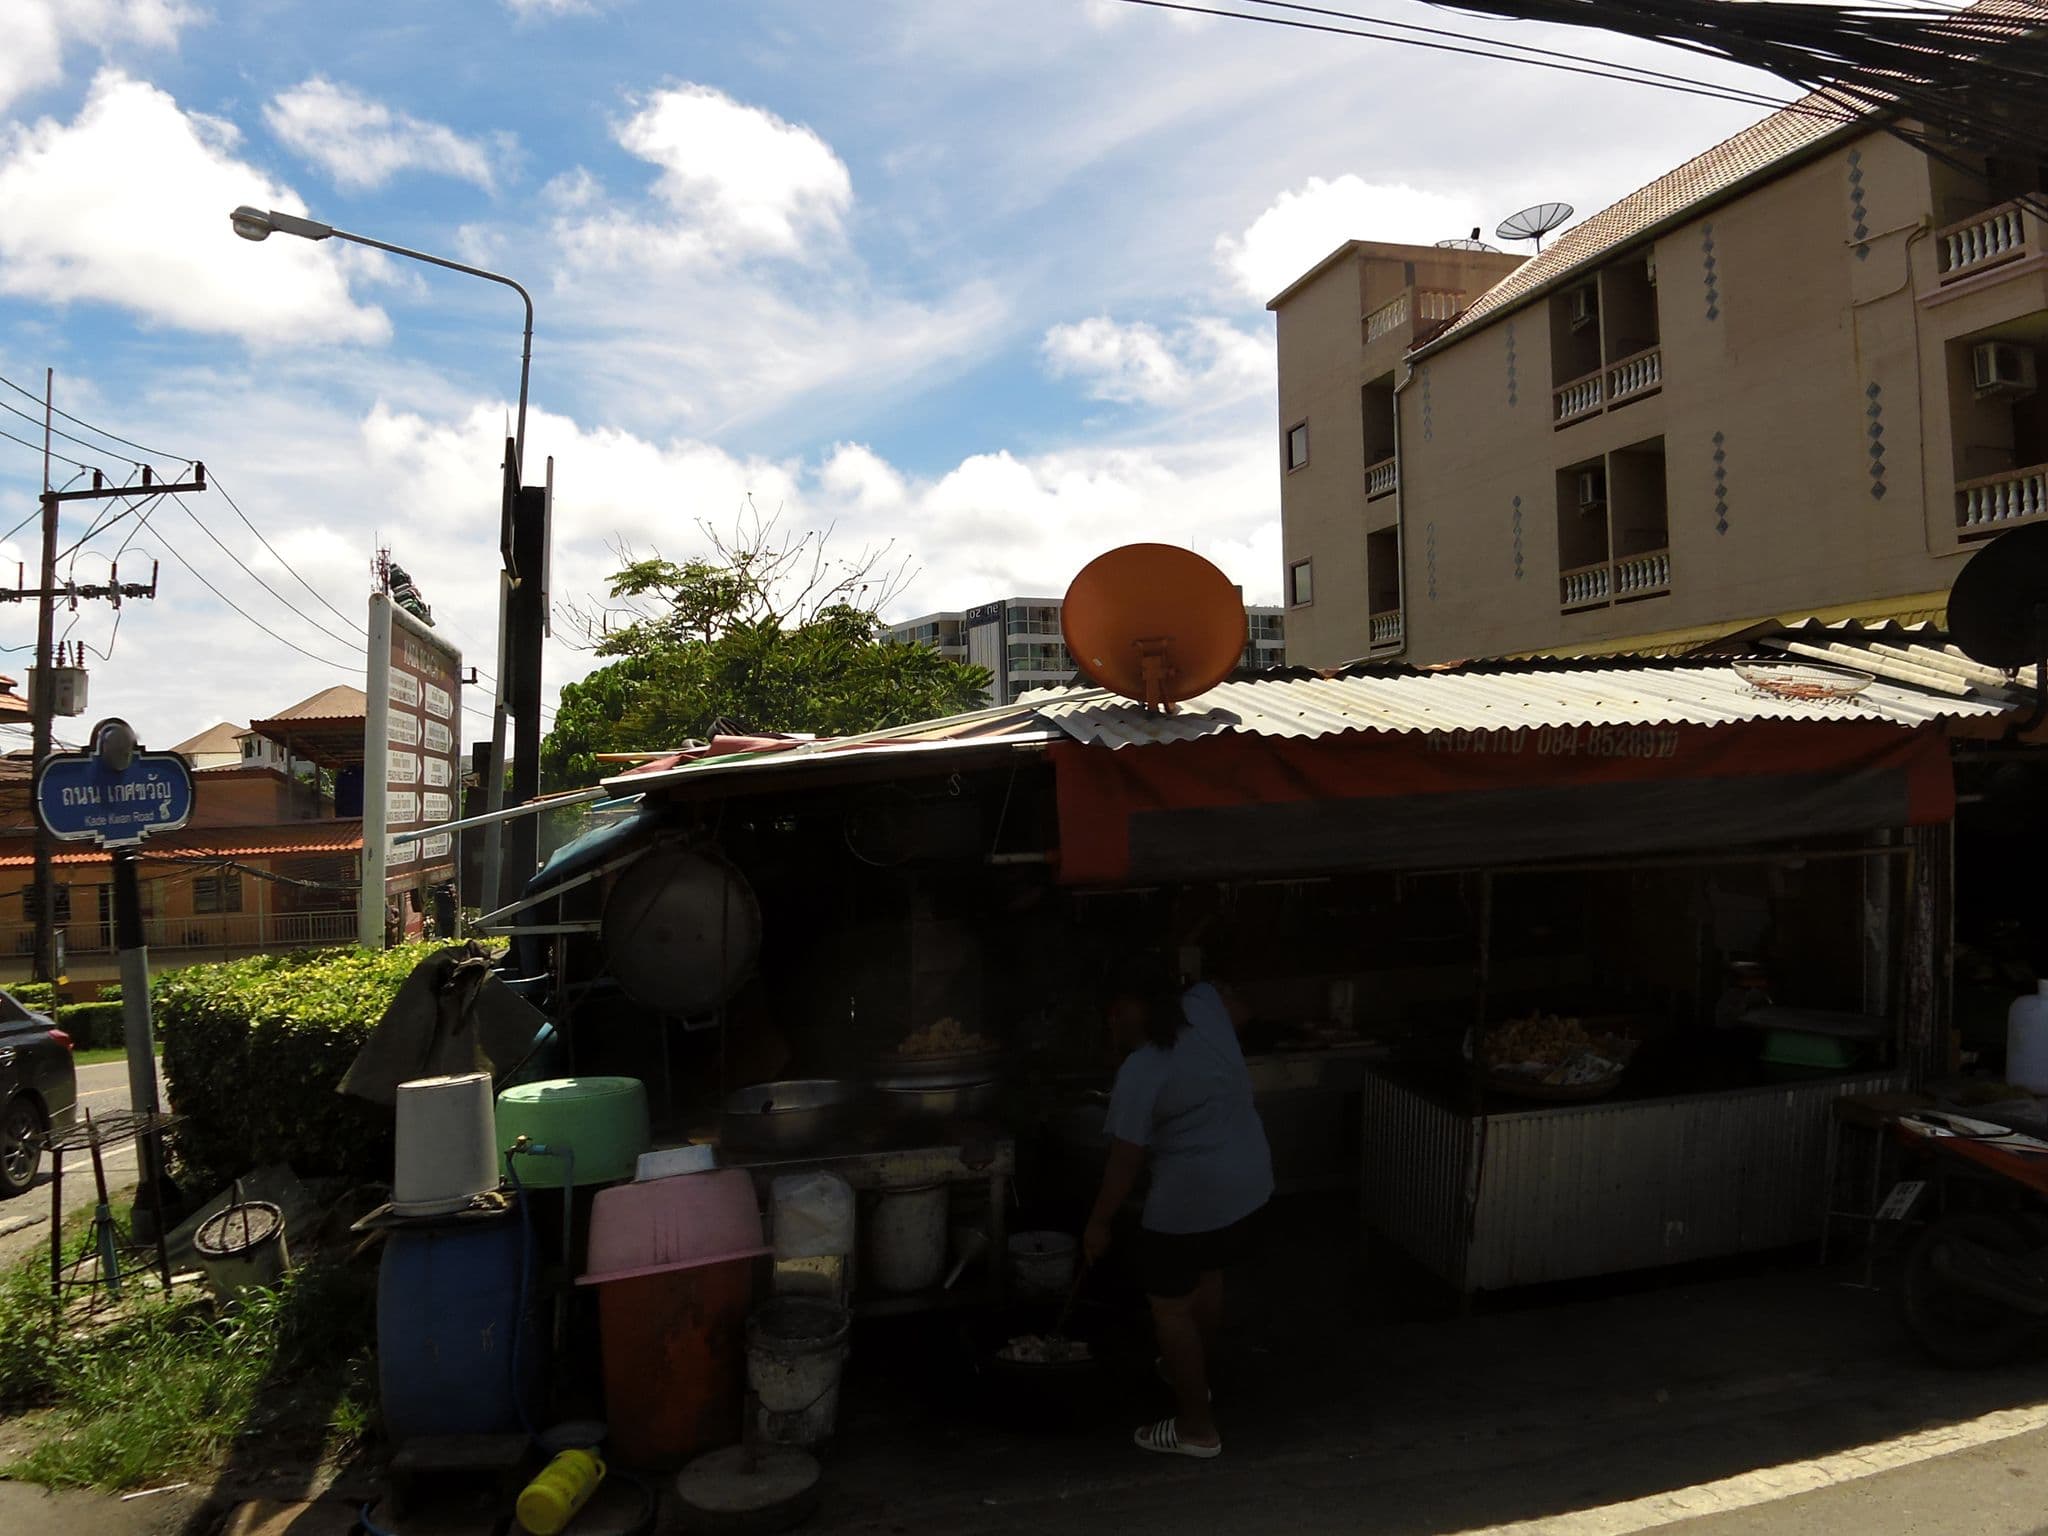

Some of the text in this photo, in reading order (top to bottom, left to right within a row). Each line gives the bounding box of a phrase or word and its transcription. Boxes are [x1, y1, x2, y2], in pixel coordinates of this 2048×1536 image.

[969, 604, 998, 619] ozne
[62, 774, 171, 806] ถนน เกศขวัญ
[133, 811, 154, 822] Road
